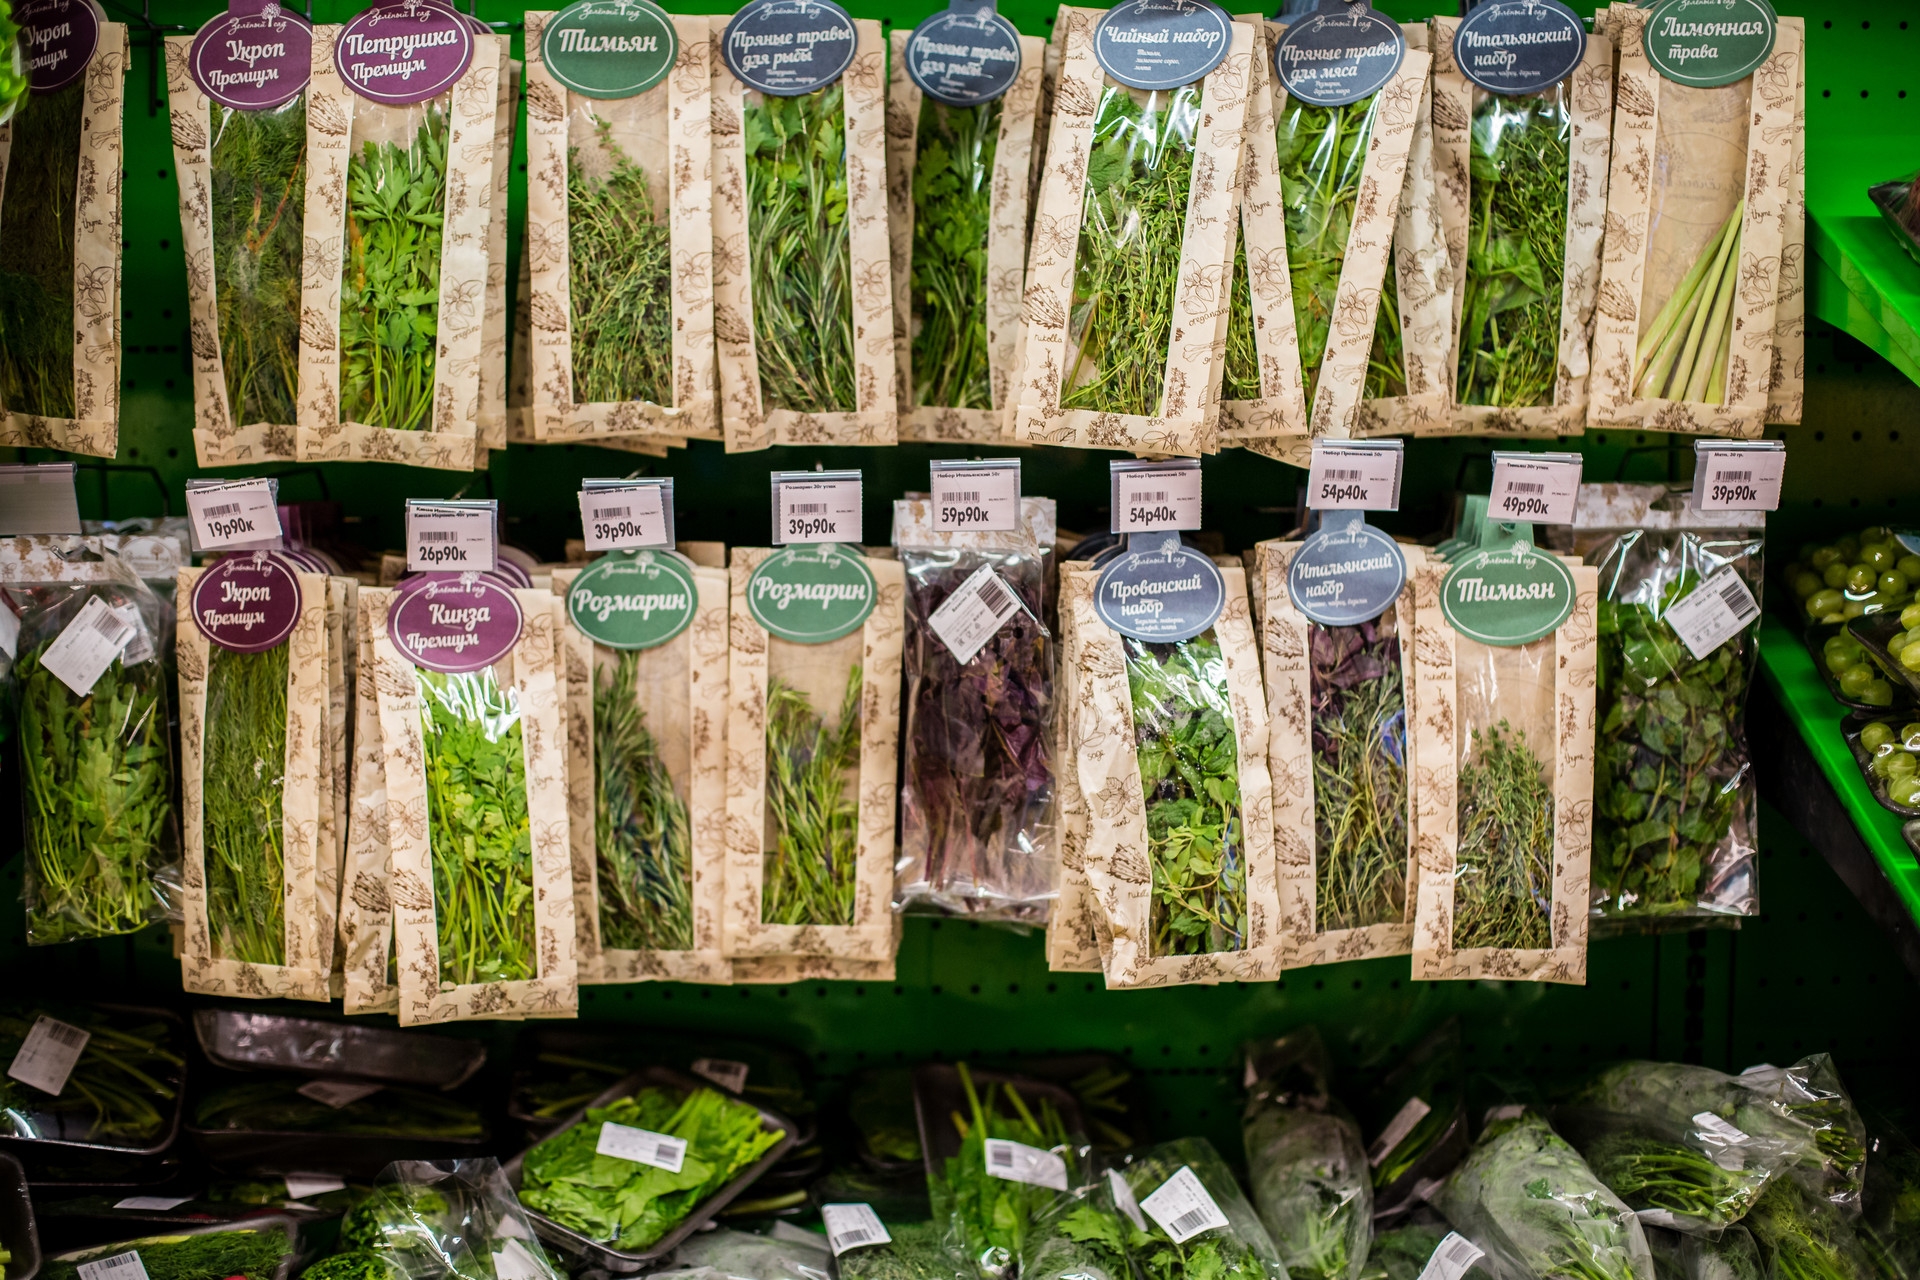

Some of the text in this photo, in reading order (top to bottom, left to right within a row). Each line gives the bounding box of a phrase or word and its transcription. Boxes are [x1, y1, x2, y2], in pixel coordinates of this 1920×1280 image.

[22, 22, 72, 52] Укроп
[1105, 25, 1222, 49] Чайный набор
[1660, 16, 1764, 37] Лимонная
[346, 30, 458, 60] Петрушка
[558, 28, 658, 53] Тимьян
[733, 26, 851, 54] Пряные травы
[1465, 27, 1573, 48] Итальянский
[226, 40, 286, 68] Укроп
[742, 48, 813, 72] для рыбы
[916, 36, 1017, 66] Пряные травы
[1281, 42, 1397, 68] Пряные травы
[1474, 50, 1517, 71] набор
[1623, 49, 1644, 59] mint
[1668, 44, 1719, 66] трава
[209, 69, 279, 92] Премиум
[313, 66, 336, 76] mint
[351, 59, 427, 85] Премиум
[920, 60, 982, 80] для рыбы
[1290, 69, 1317, 87] для
[1320, 66, 1358, 79] мяса
[1765, 93, 1794, 112] oregano
[1385, 119, 1415, 137] oregano
[1249, 201, 1273, 218] thyme
[1751, 208, 1773, 225] thyme
[1195, 213, 1219, 229] thyme
[1355, 237, 1378, 254] thyme
[1341, 330, 1371, 348] oregano
[1321, 484, 1369, 504] 54р40к
[1711, 485, 1758, 505] 39р90к
[941, 506, 990, 526] 59р90к
[1129, 506, 1177, 526] 54р40к
[1502, 496, 1550, 517] 49р90к
[207, 517, 255, 539] 19р90к
[594, 521, 643, 542] 39р90к
[788, 518, 837, 538] 39р90к
[418, 546, 468, 565] 26р90к
[1297, 552, 1393, 580] Итальянский
[221, 581, 271, 610] Укроп
[756, 576, 866, 610] Розмарин
[1109, 574, 1202, 604] Прованский
[1305, 579, 1344, 602] набор
[1456, 577, 1556, 603] Тимьян
[575, 589, 687, 622] Розмарин
[1120, 598, 1164, 619] набор
[203, 609, 266, 632] Премиум
[428, 604, 491, 632] Кинза
[406, 632, 480, 655] Премиум
